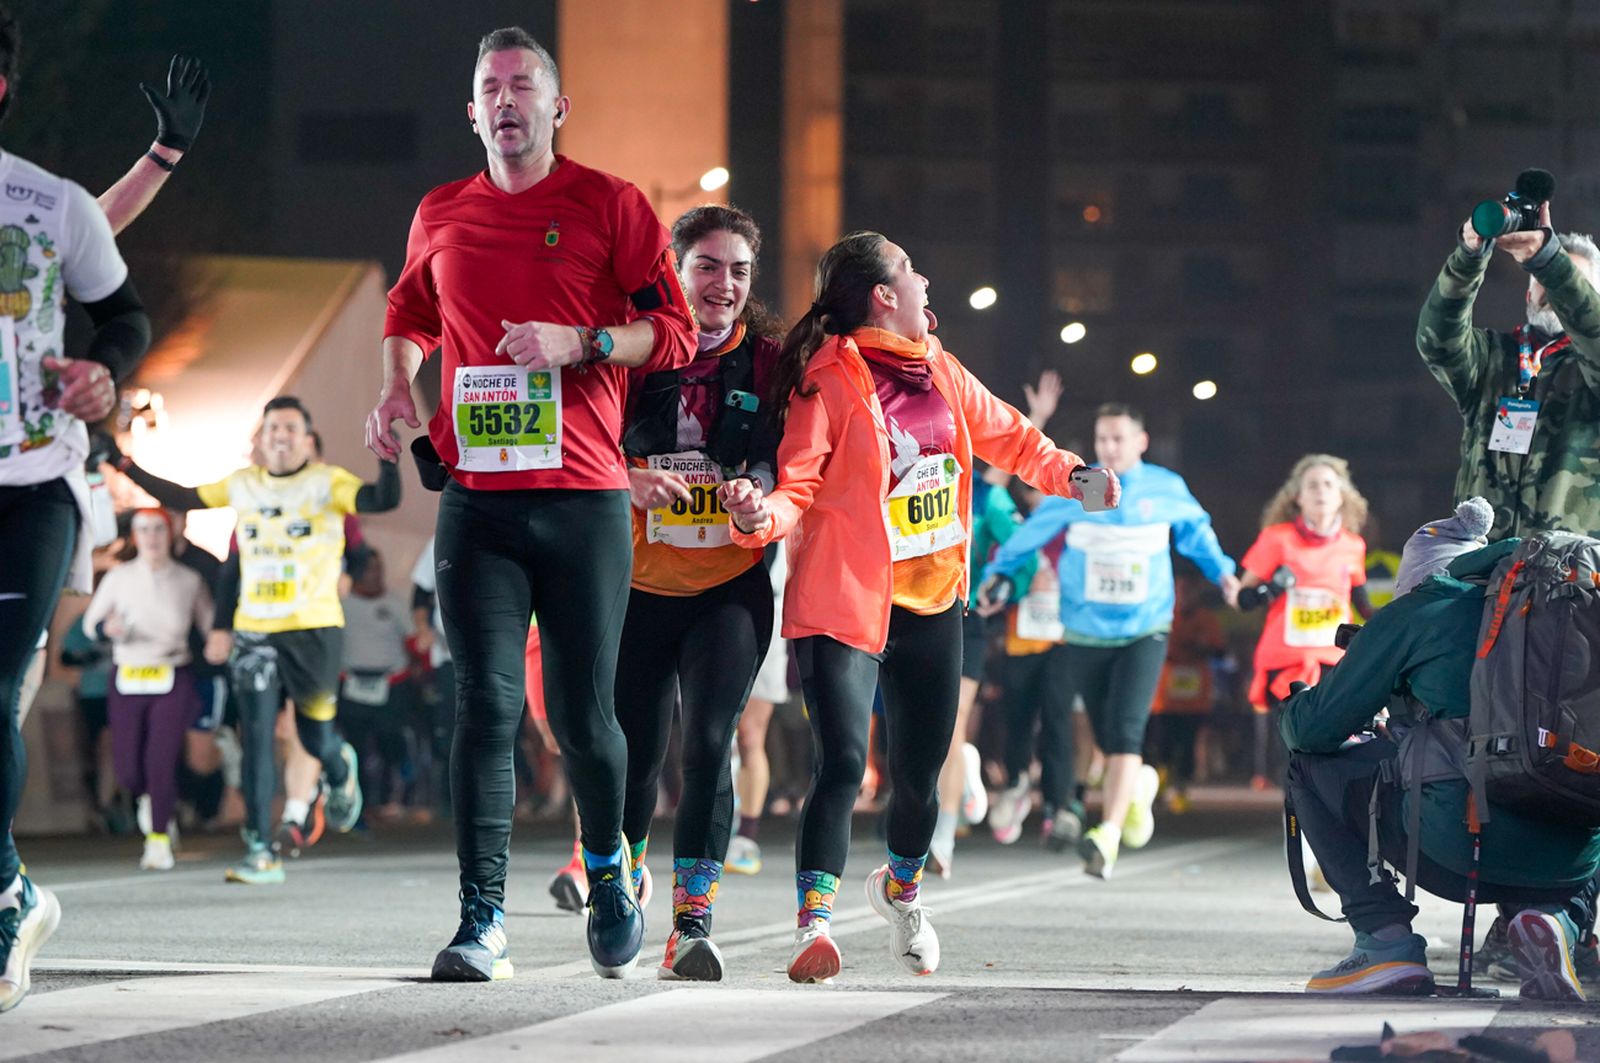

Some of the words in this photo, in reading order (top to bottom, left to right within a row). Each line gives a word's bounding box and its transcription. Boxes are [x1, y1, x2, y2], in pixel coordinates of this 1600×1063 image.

[472, 378, 502, 388] NOCHE
[504, 377, 517, 388] DE
[463, 391, 480, 403] SAN
[481, 387, 518, 402] ANTÓN
[469, 403, 541, 436] 5532
[488, 437, 518, 446] Santiago
[672, 461, 705, 471] NOCHE
[930, 465, 939, 476] DE
[670, 486, 730, 516] 601
[907, 487, 950, 525] 6017
